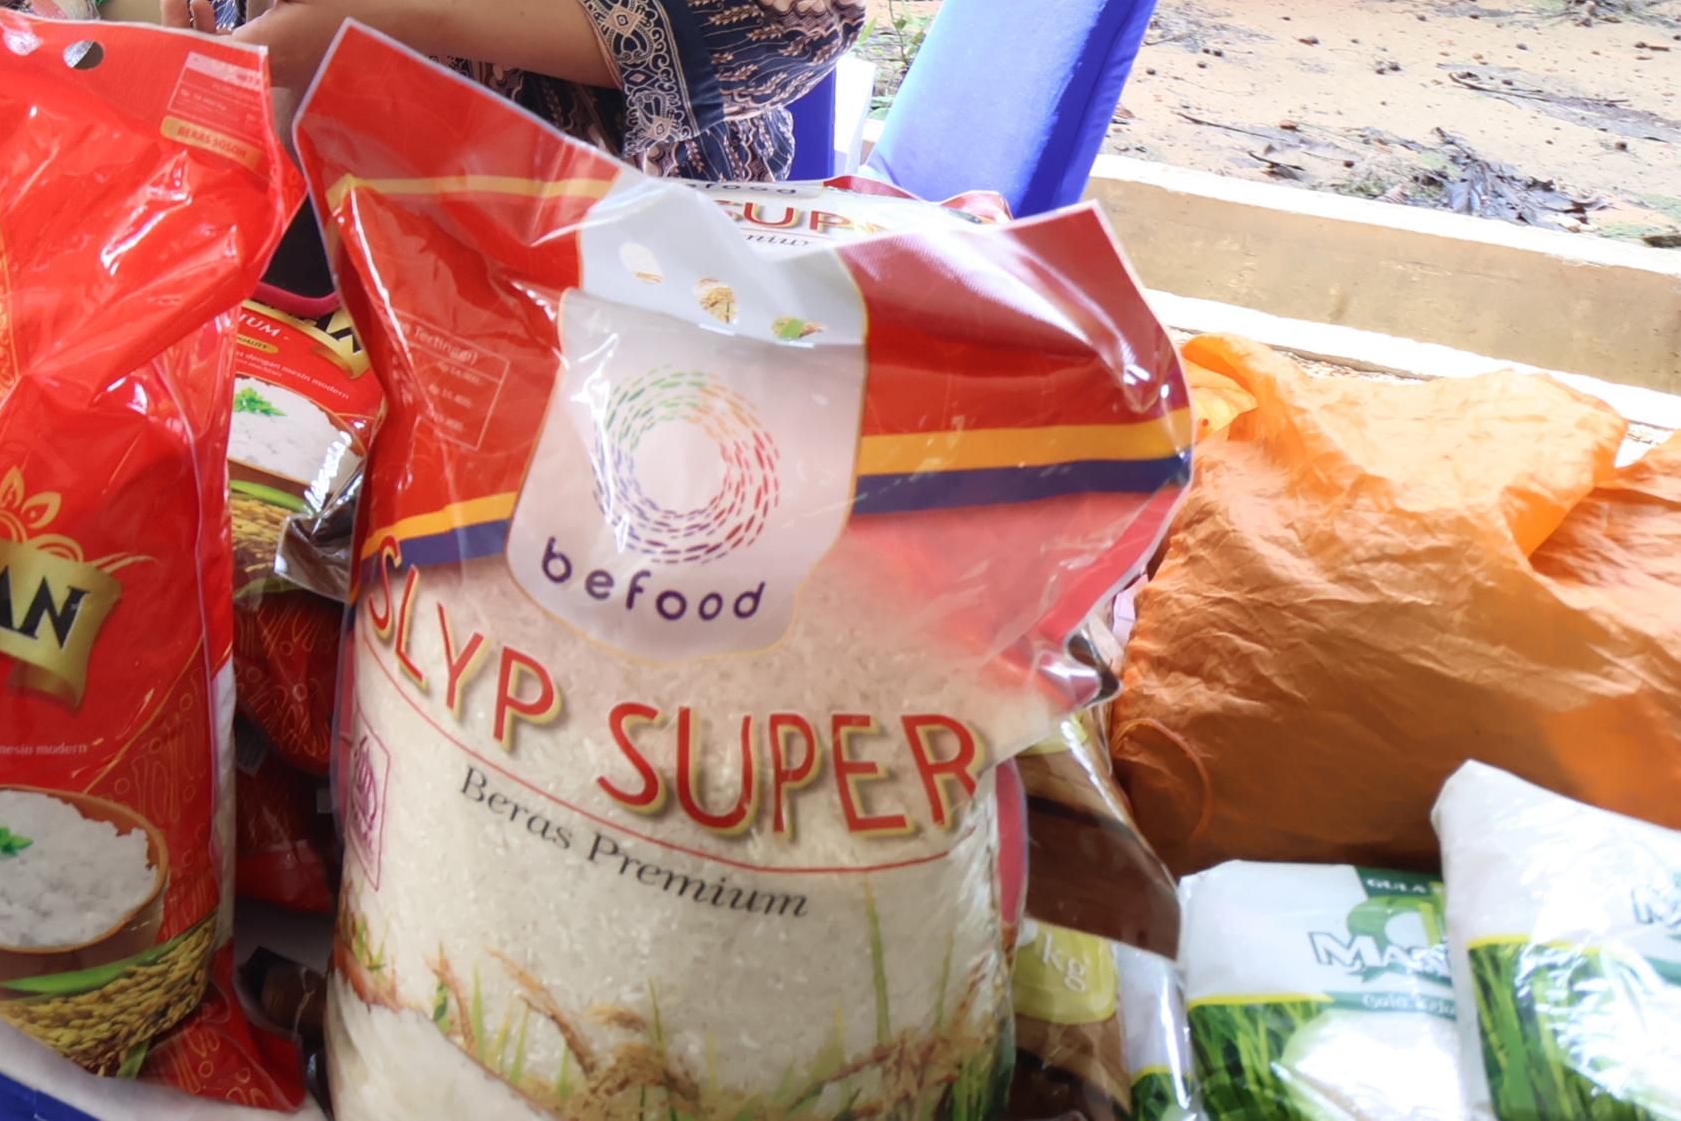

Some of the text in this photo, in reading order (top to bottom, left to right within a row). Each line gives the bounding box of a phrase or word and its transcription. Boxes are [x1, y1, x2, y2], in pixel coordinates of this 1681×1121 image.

[245, 351, 281, 371] dengan
[541, 535, 766, 622] befood
[366, 533, 986, 839] SLYP SUPER
[35, 740, 88, 755] modern
[456, 764, 574, 852] Beras
[584, 829, 810, 921] Premium
[1042, 935, 1088, 994] kg
